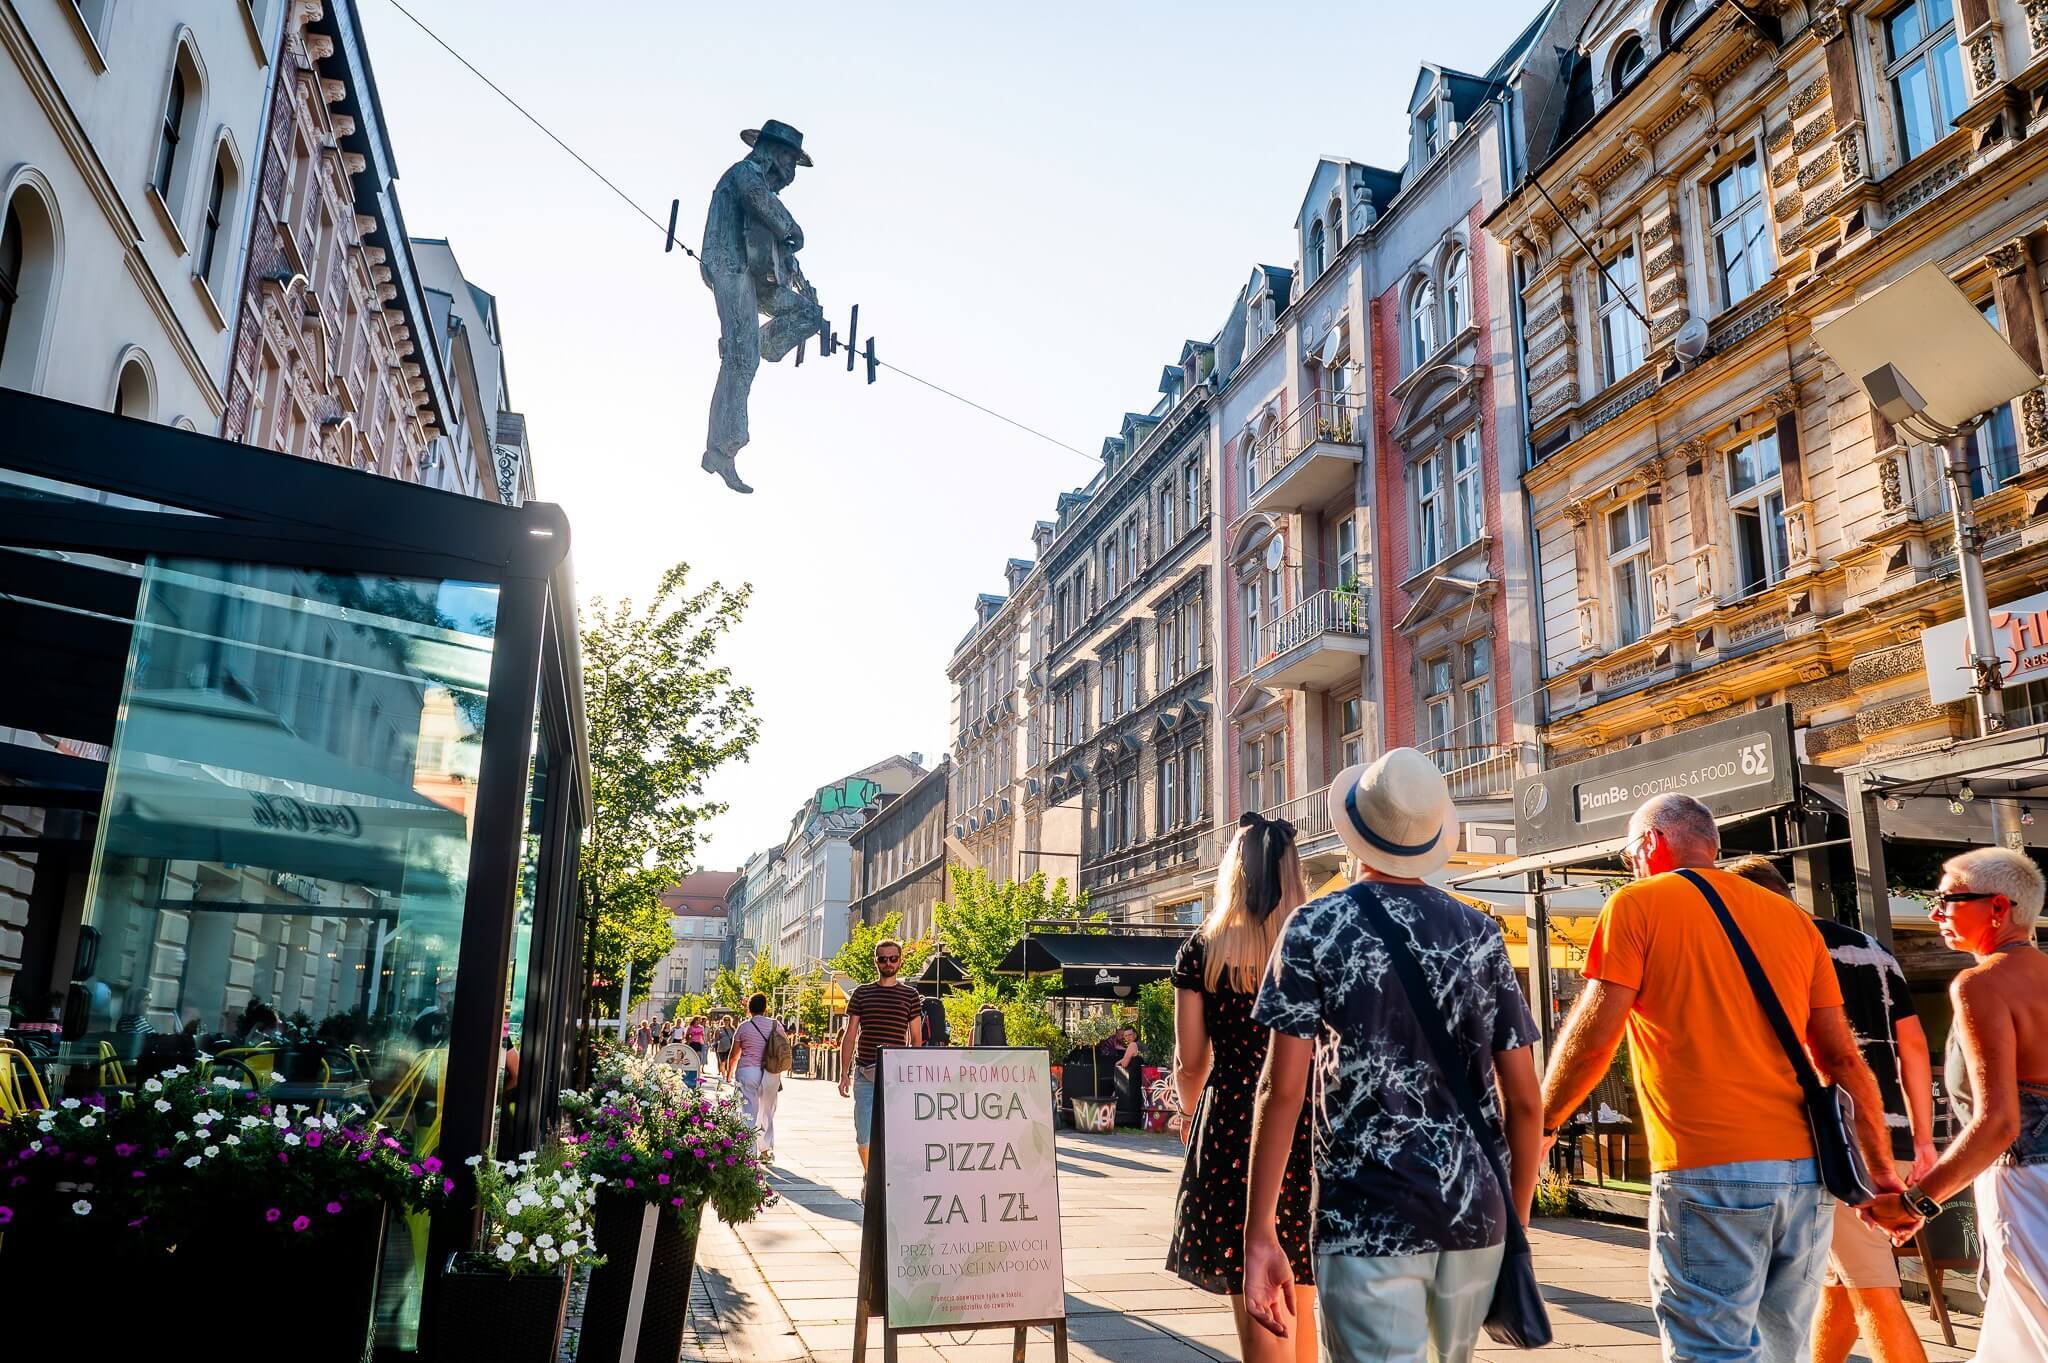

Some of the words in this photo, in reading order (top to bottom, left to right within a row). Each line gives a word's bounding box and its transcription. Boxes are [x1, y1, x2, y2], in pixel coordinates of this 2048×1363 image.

[1580, 786, 1628, 811] PlanBe
[1632, 773, 1687, 798] COCTAILS
[1689, 770, 1700, 785] &
[1701, 761, 1736, 782] FOOD
[899, 1064, 951, 1083] LETNIA
[959, 1065, 1037, 1083] PROMOCJA
[914, 1092, 1027, 1121] DRUGA
[924, 1142, 1022, 1172] PIZZA
[922, 1194, 969, 1225] ZA
[980, 1195, 988, 1223] 1
[998, 1192, 1039, 1222] ZŁ
[900, 1243, 936, 1257] PRZY
[941, 1240, 995, 1255] ZAKUPIE
[999, 1238, 1049, 1253] DWÓCH
[897, 1262, 986, 1279] DOWOLNYCH
[987, 1257, 1051, 1274] NAPOJÓW
